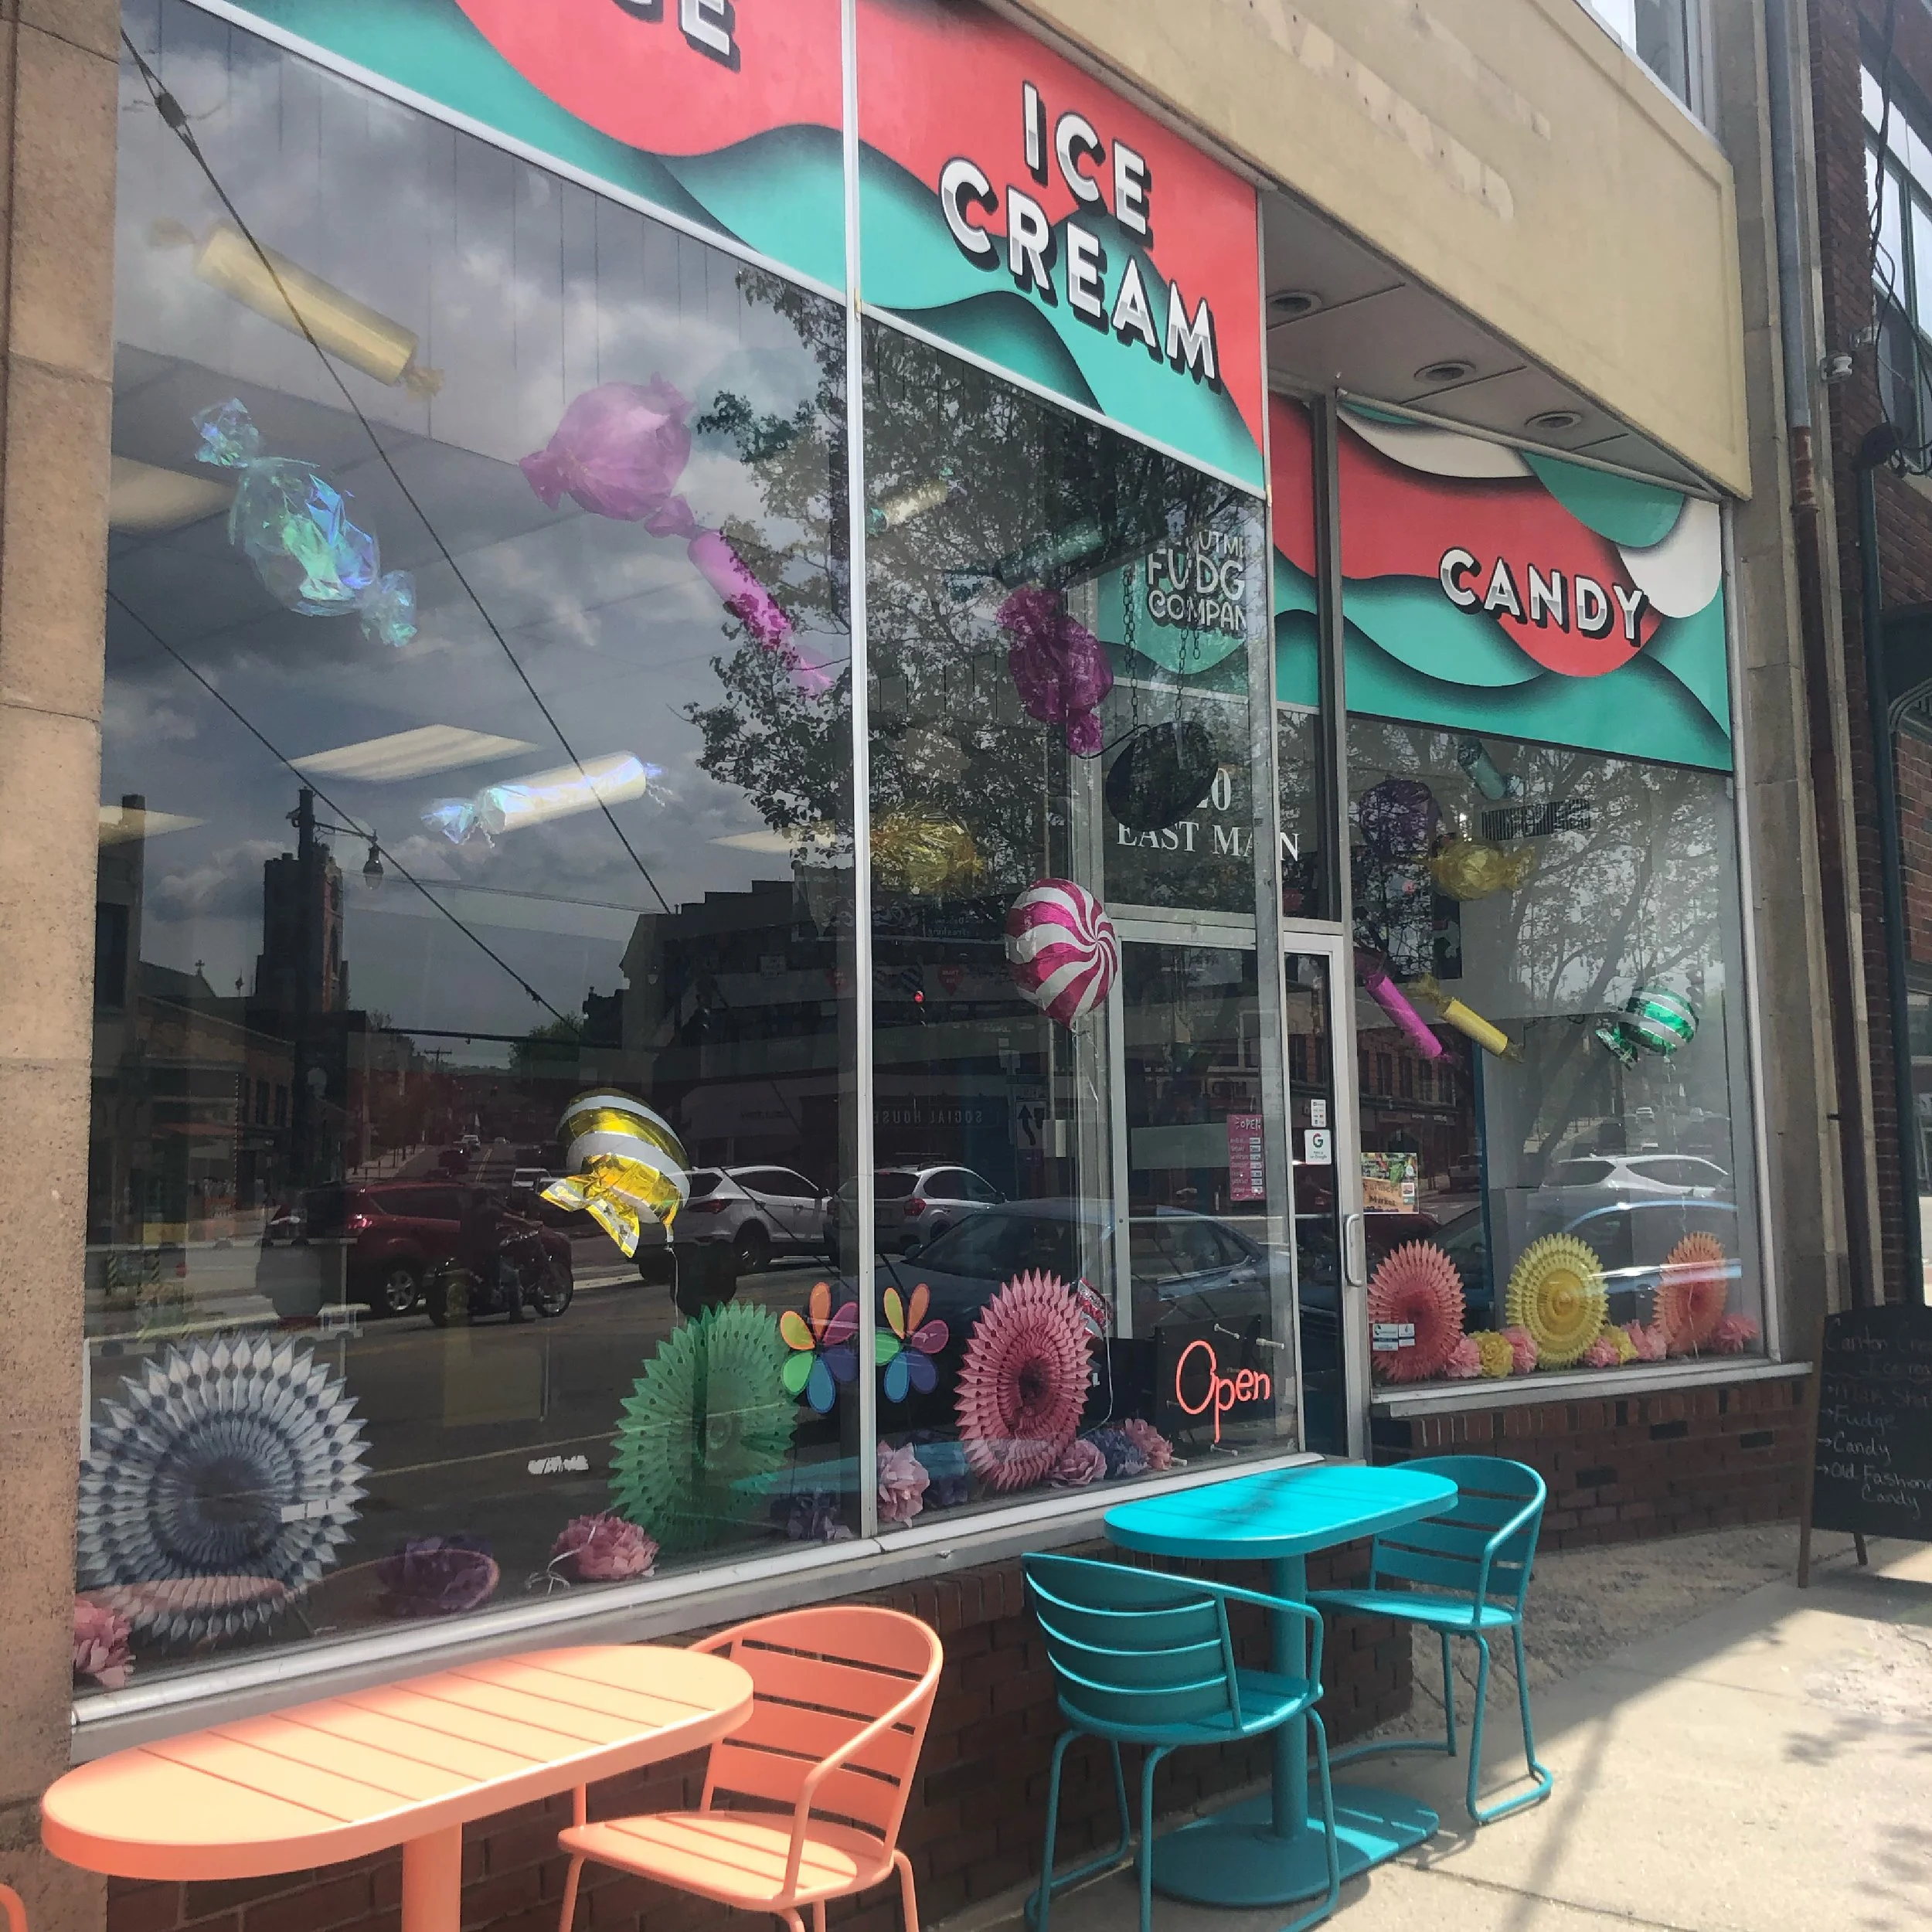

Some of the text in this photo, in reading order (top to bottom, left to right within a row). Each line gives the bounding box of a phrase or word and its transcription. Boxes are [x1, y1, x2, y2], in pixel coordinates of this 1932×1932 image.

[1022, 80, 1152, 247] ICE
[938, 157, 1221, 391] CREAM
[1440, 547, 1648, 646] CANDY
[1117, 820, 1299, 862] EAST MN
[1175, 1340, 1271, 1444] Open
[1832, 1403, 1894, 1436] Fudge
[1832, 1430, 1892, 1466] Candy
[1830, 1461, 1855, 1479] Old
[1861, 1482, 1921, 1521] Candy
